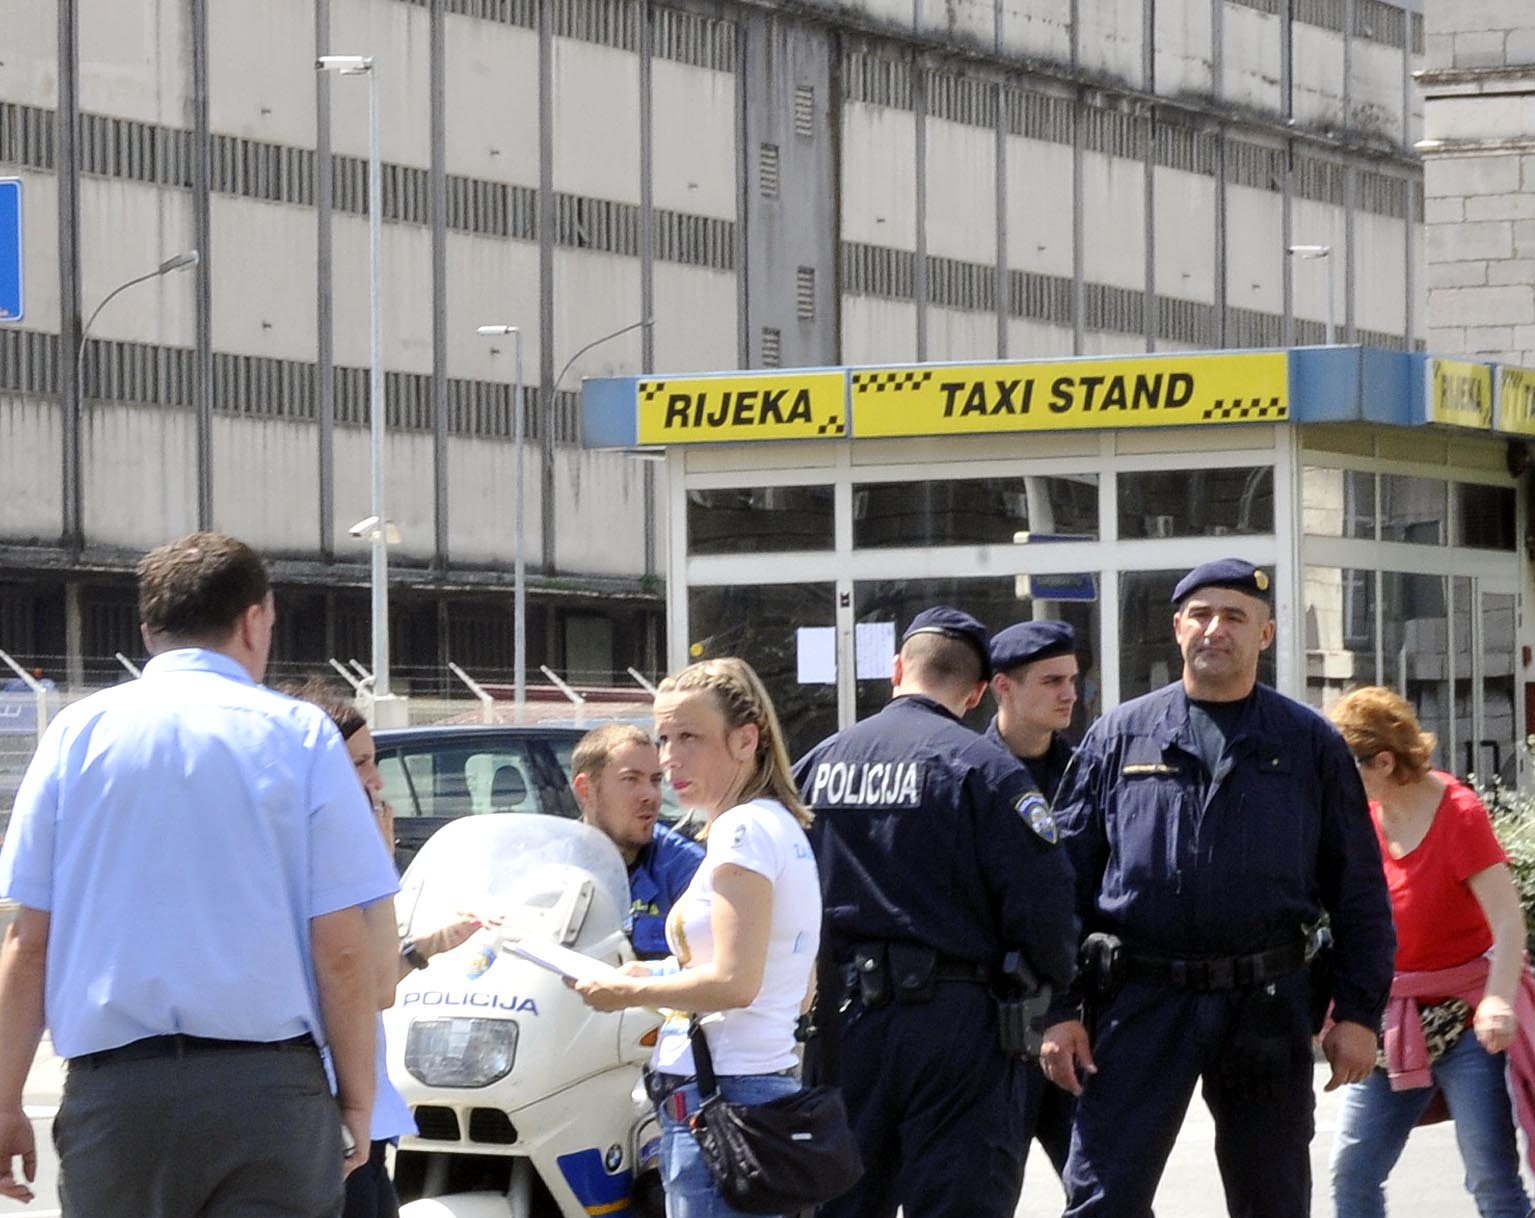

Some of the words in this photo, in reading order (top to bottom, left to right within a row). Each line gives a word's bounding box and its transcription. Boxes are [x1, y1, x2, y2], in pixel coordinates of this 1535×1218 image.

[664, 389, 813, 429] RIJEKA
[939, 379, 1034, 417] TAXI
[1048, 373, 1195, 413] STAND
[811, 761, 917, 805] POLICIJA
[403, 991, 539, 1016] POLICIJA
